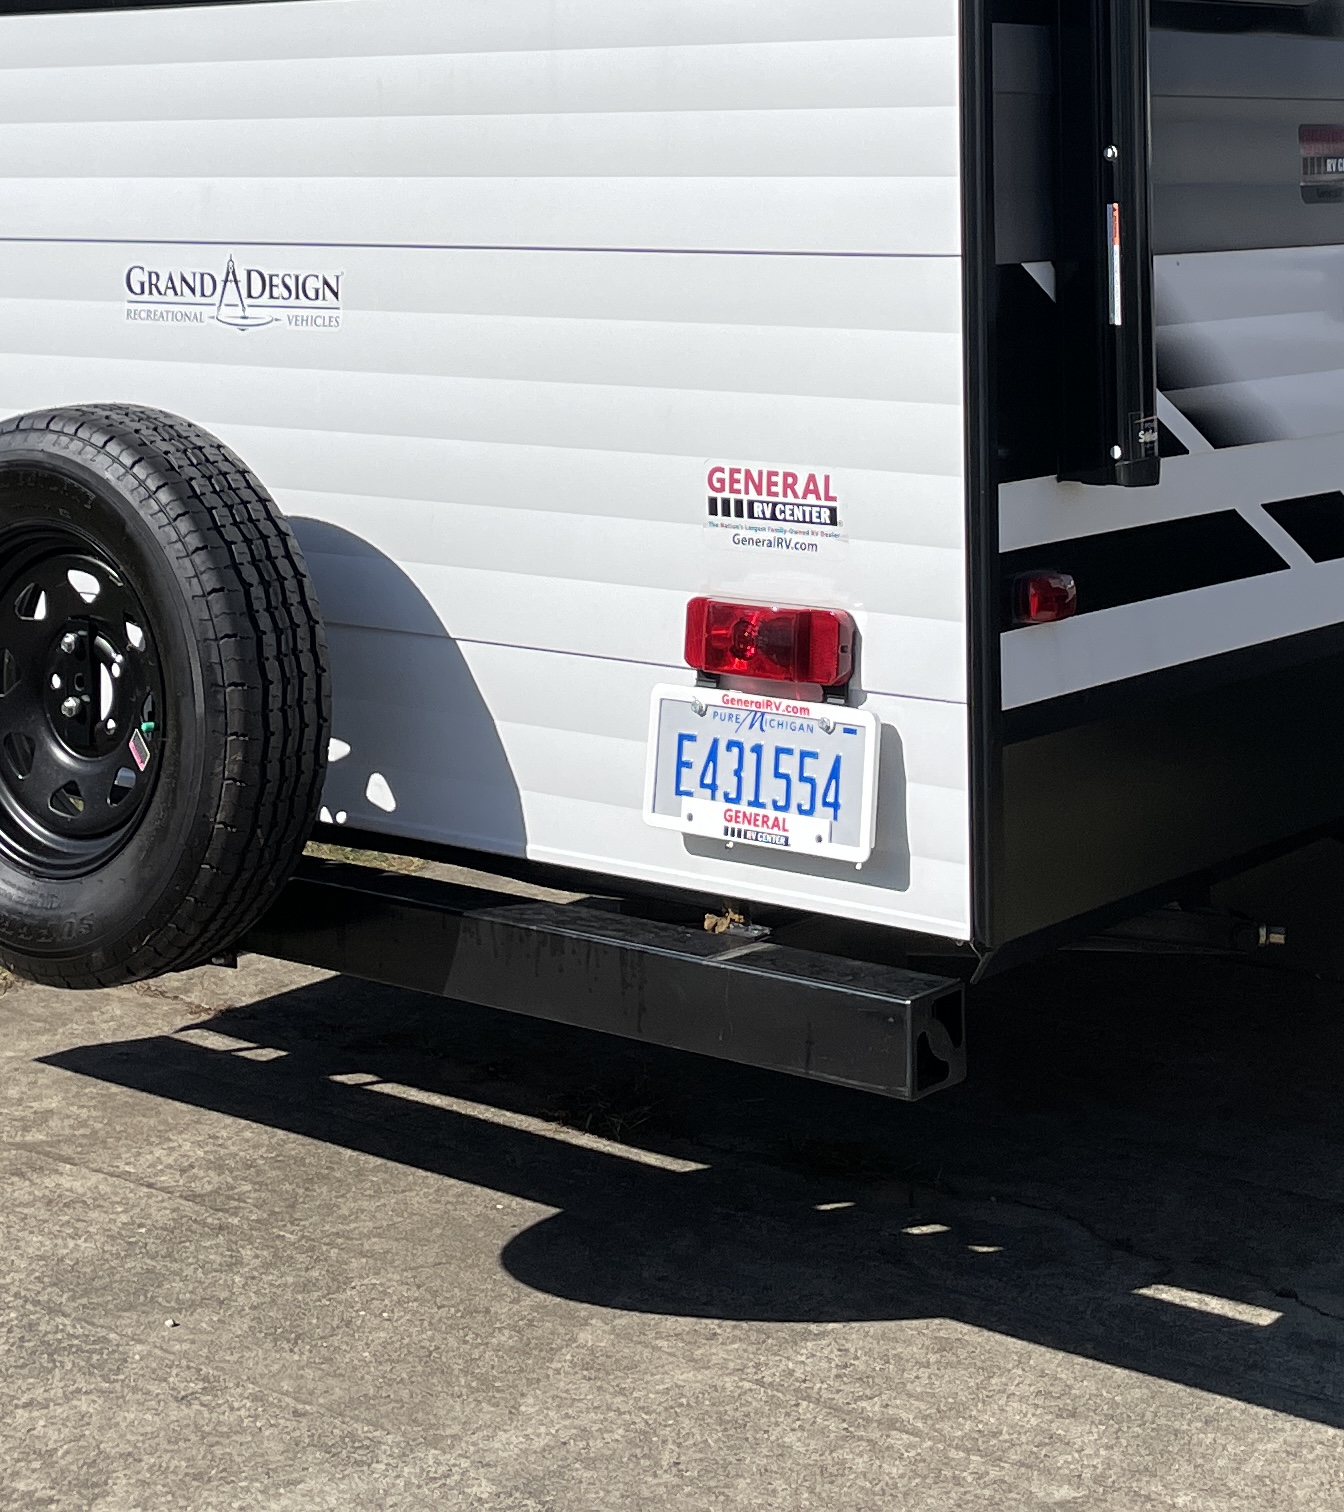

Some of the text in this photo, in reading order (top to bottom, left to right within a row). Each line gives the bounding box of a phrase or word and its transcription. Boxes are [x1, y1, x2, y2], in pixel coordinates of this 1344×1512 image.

[1326, 158, 1337, 173] RV
[125, 265, 342, 302] GRAND DESIGN
[125, 308, 341, 328] RECREATIONAL VEHICLES
[707, 466, 837, 502] GENERAL
[753, 501, 830, 523] RV CENTER
[732, 533, 819, 553] GeneralRV.com
[721, 693, 811, 717] GeneralRV.com
[712, 709, 815, 734] PURE MICHIGAN
[675, 732, 843, 821] E431554
[723, 808, 790, 833] GENERAL
[746, 830, 786, 846] RV CENTER
